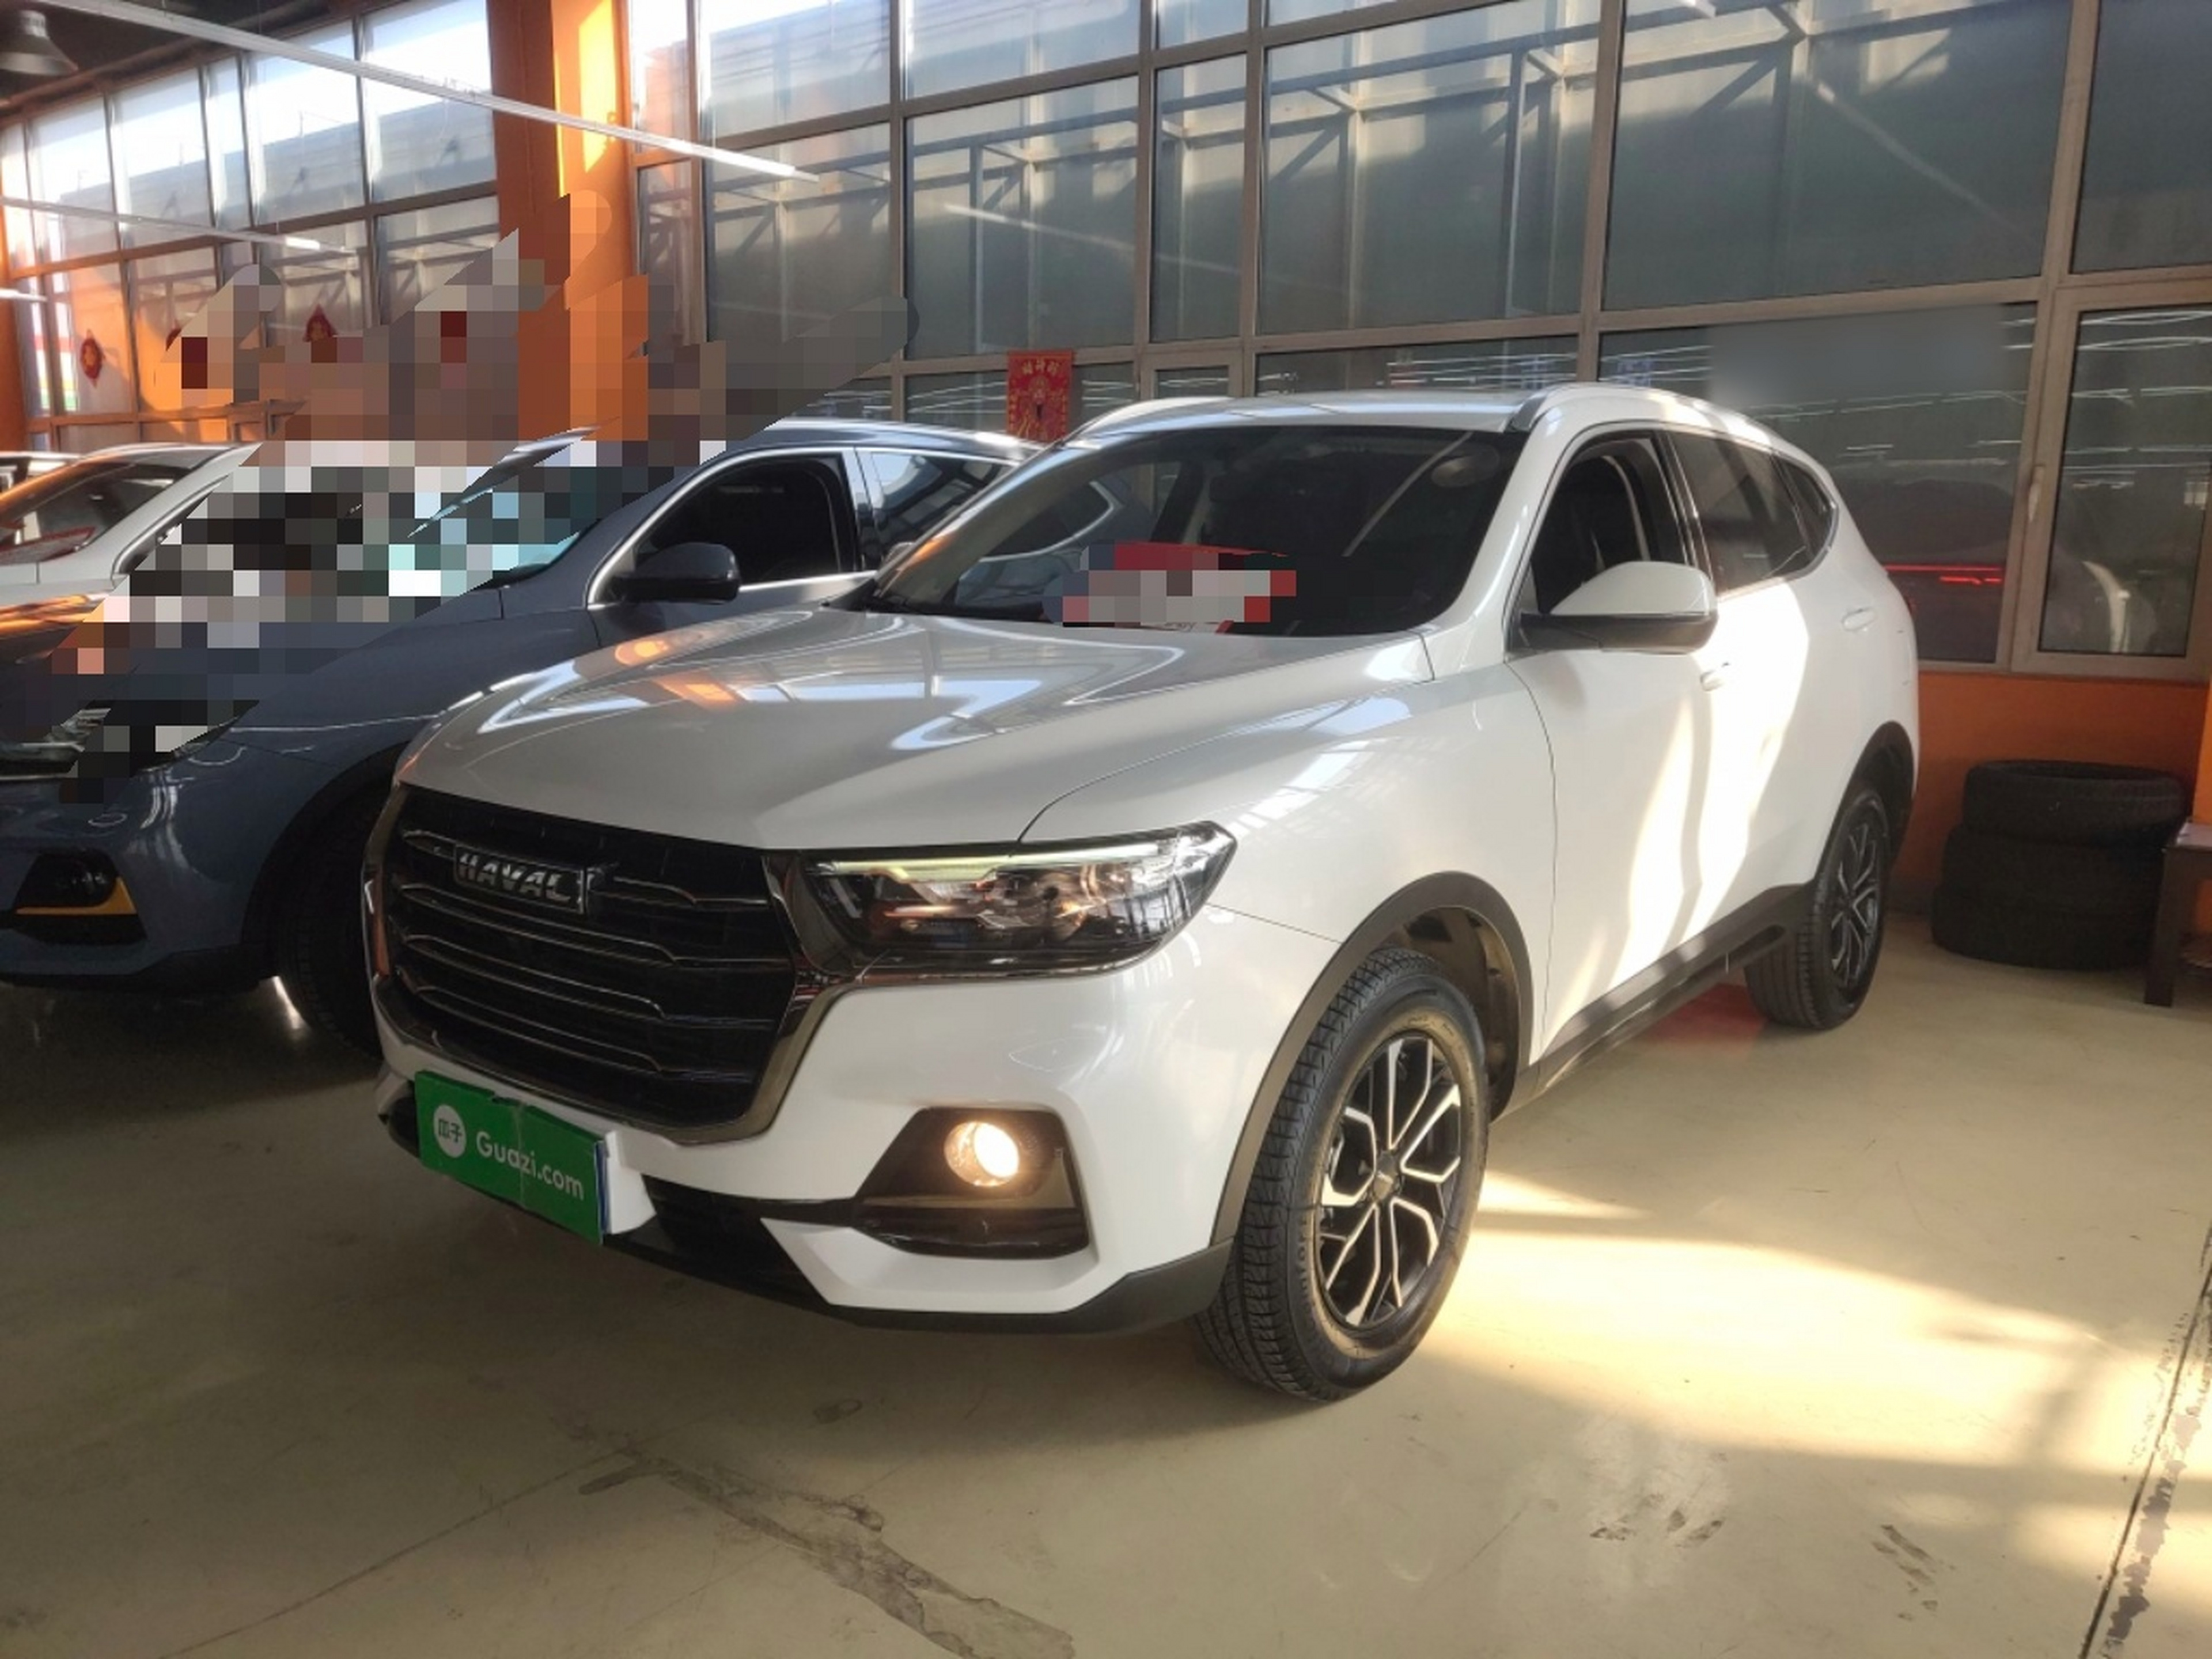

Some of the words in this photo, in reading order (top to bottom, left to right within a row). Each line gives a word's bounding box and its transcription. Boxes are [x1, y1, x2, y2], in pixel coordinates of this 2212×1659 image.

[459, 853, 571, 903] HAVAL
[438, 1118, 463, 1143] 瓜子
[475, 1130, 585, 1201] Guazi.com
